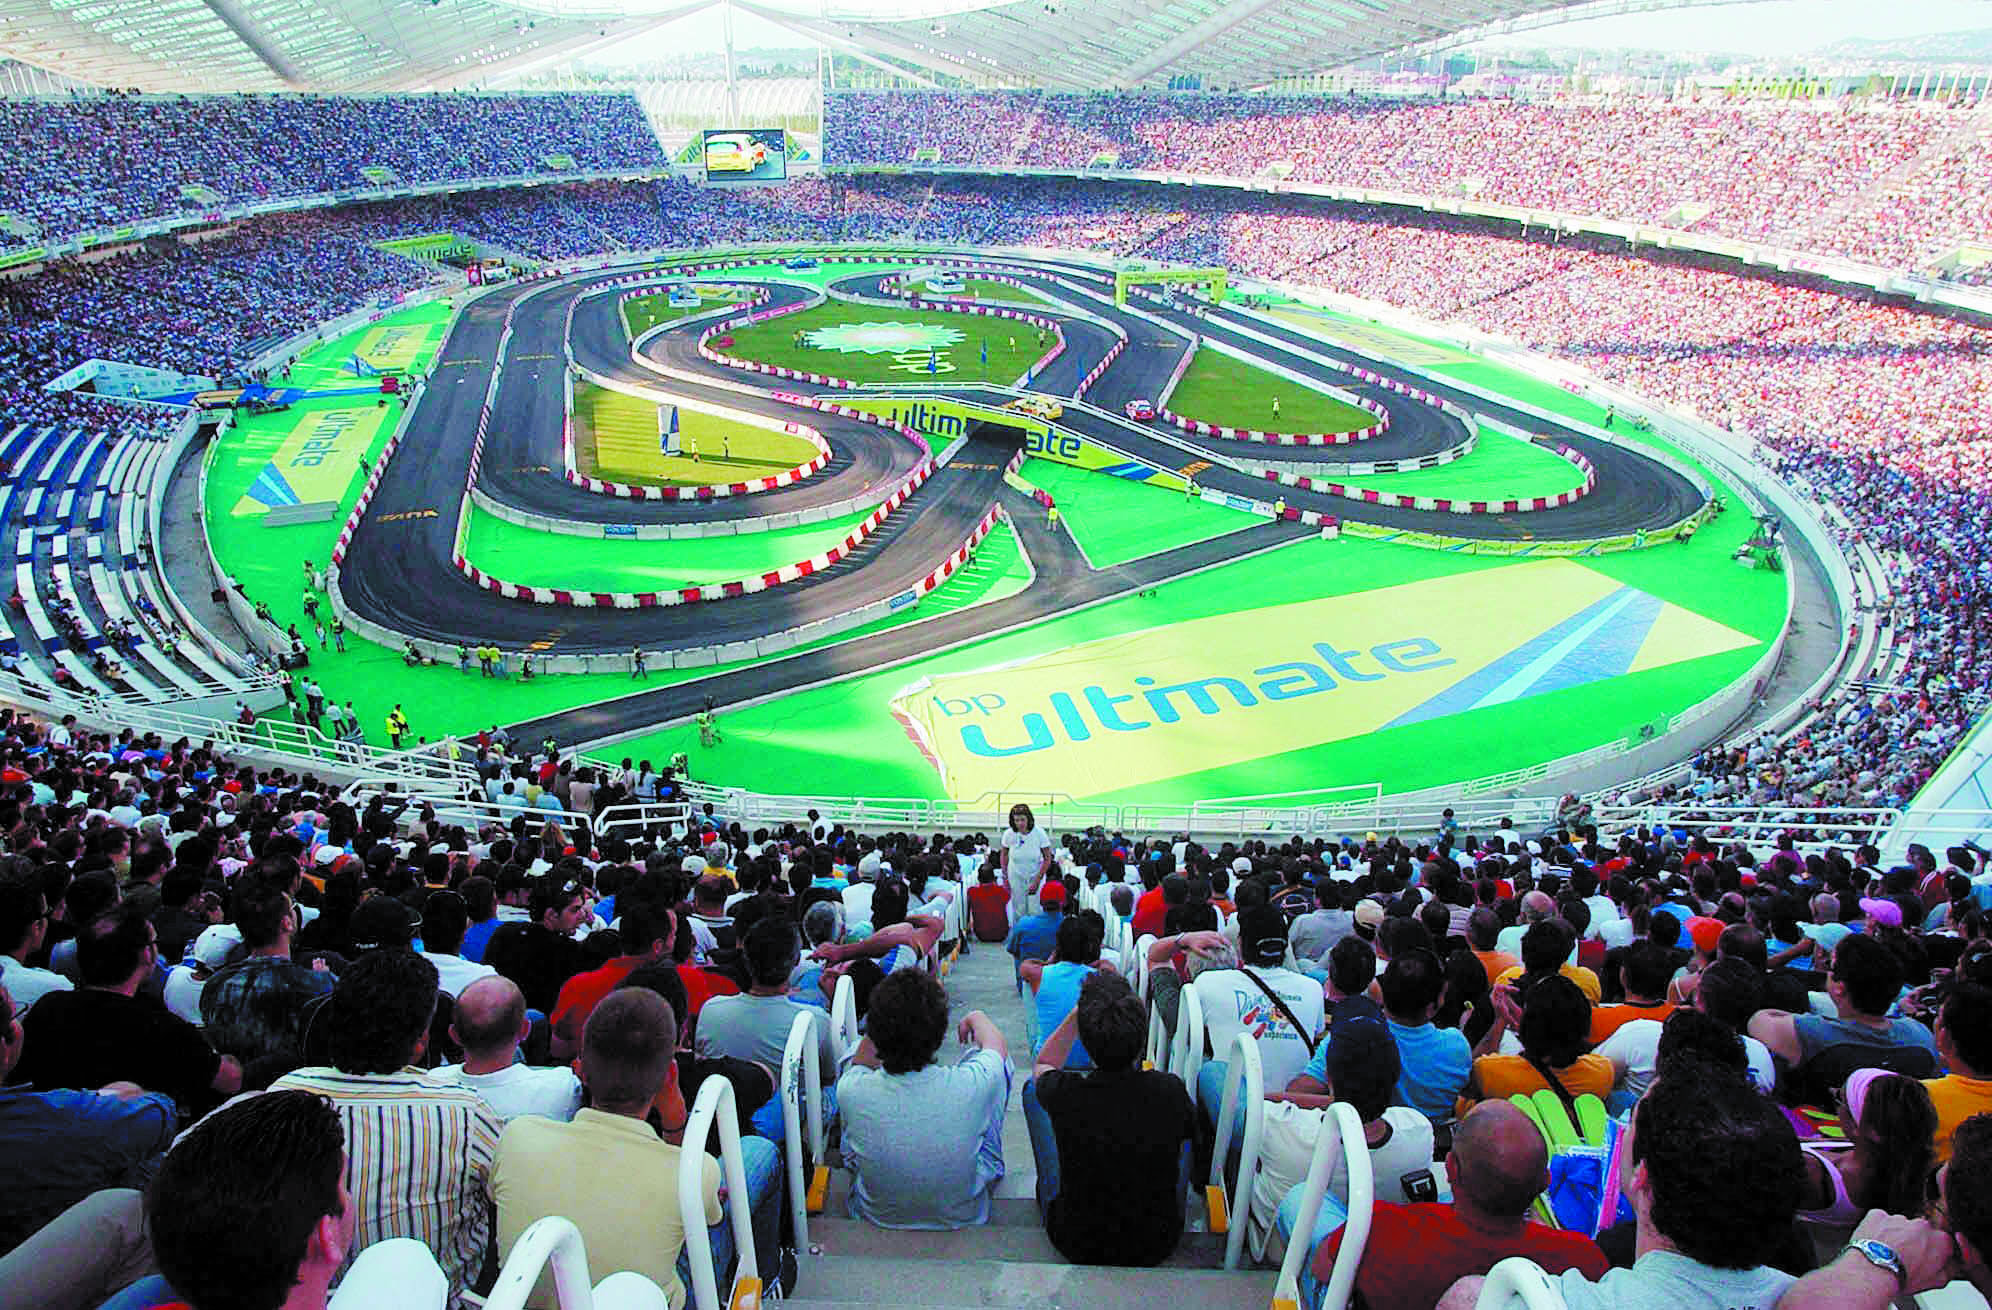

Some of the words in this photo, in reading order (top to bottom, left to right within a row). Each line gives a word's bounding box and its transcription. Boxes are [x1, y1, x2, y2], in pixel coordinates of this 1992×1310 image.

[290, 411, 359, 467] ultimate
[932, 692, 1006, 717] bp
[960, 637, 1456, 758] ultimate
